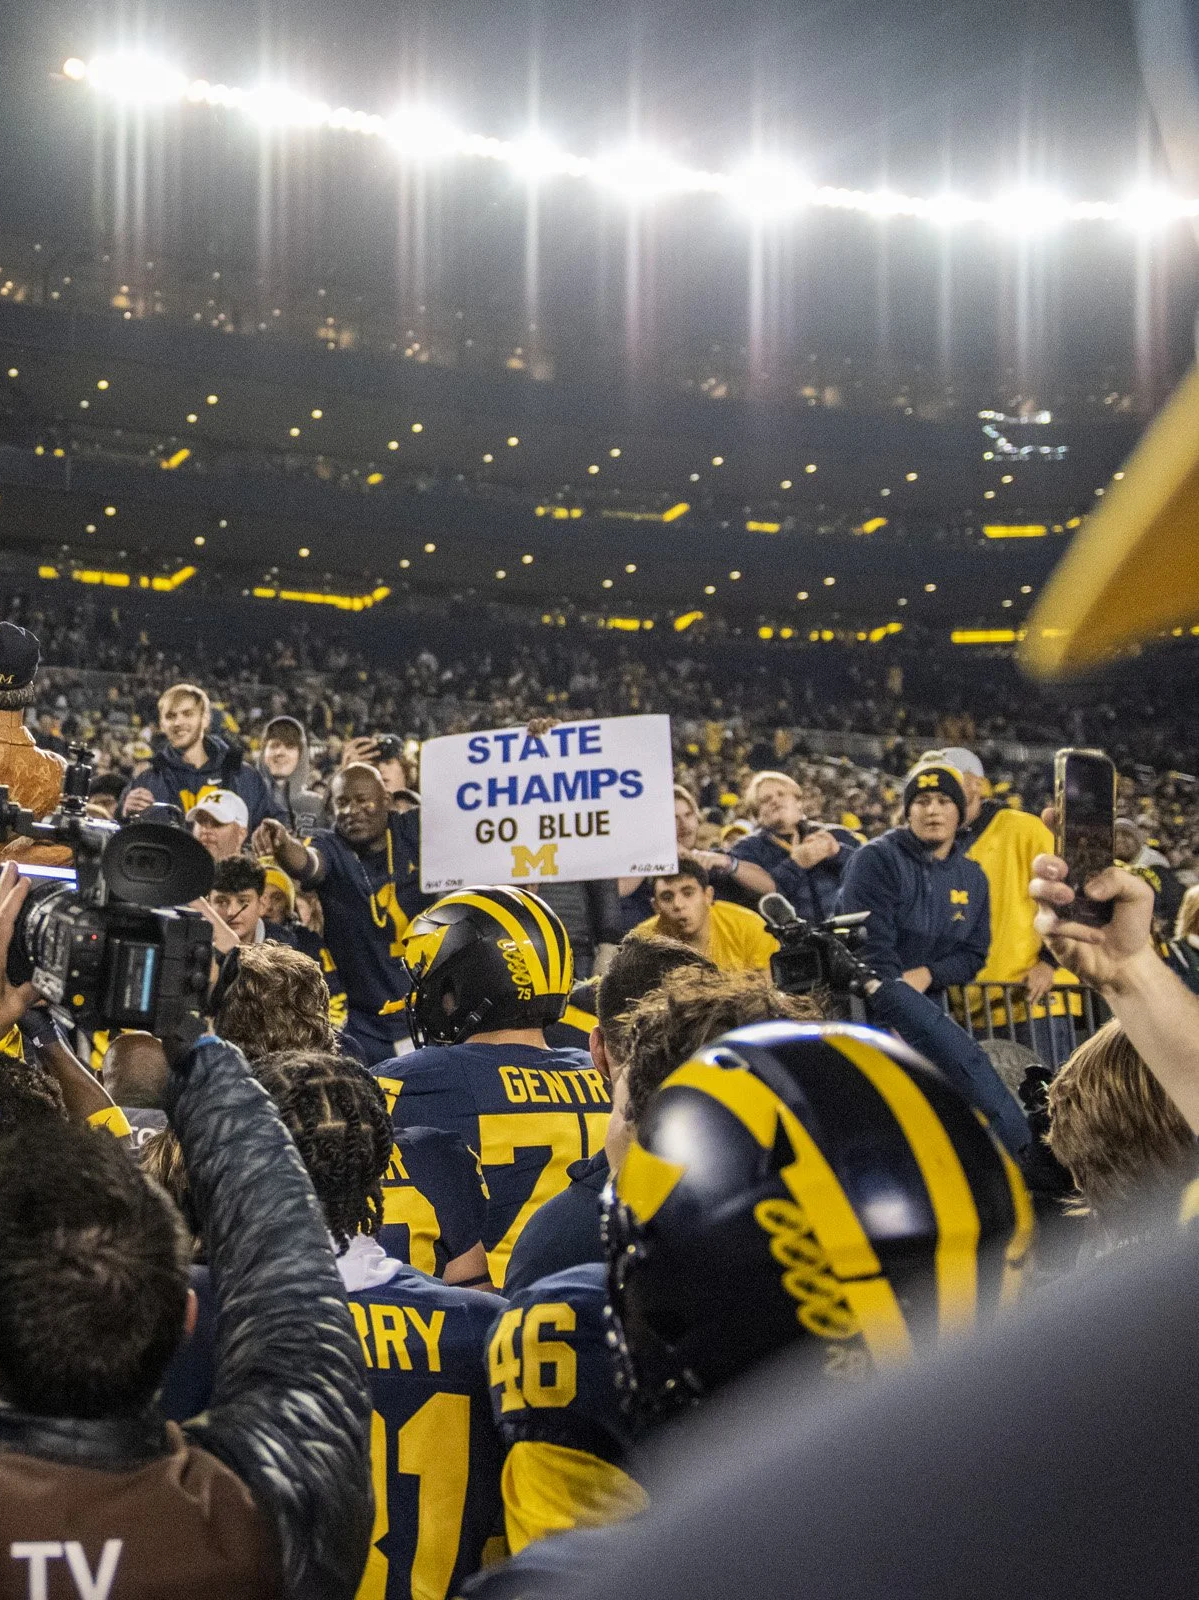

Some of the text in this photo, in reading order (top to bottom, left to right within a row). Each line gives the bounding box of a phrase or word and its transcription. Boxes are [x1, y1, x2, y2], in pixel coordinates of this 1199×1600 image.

[467, 724, 602, 765] STATE
[204, 793, 223, 804] M
[456, 768, 644, 811] CHAMPS
[476, 811, 610, 844] GO BLUE
[511, 844, 559, 877] M
[949, 889, 969, 905] M
[517, 987, 532, 1001] 75
[488, 1302, 577, 1414] 46
[10, 1538, 124, 1600] TV
